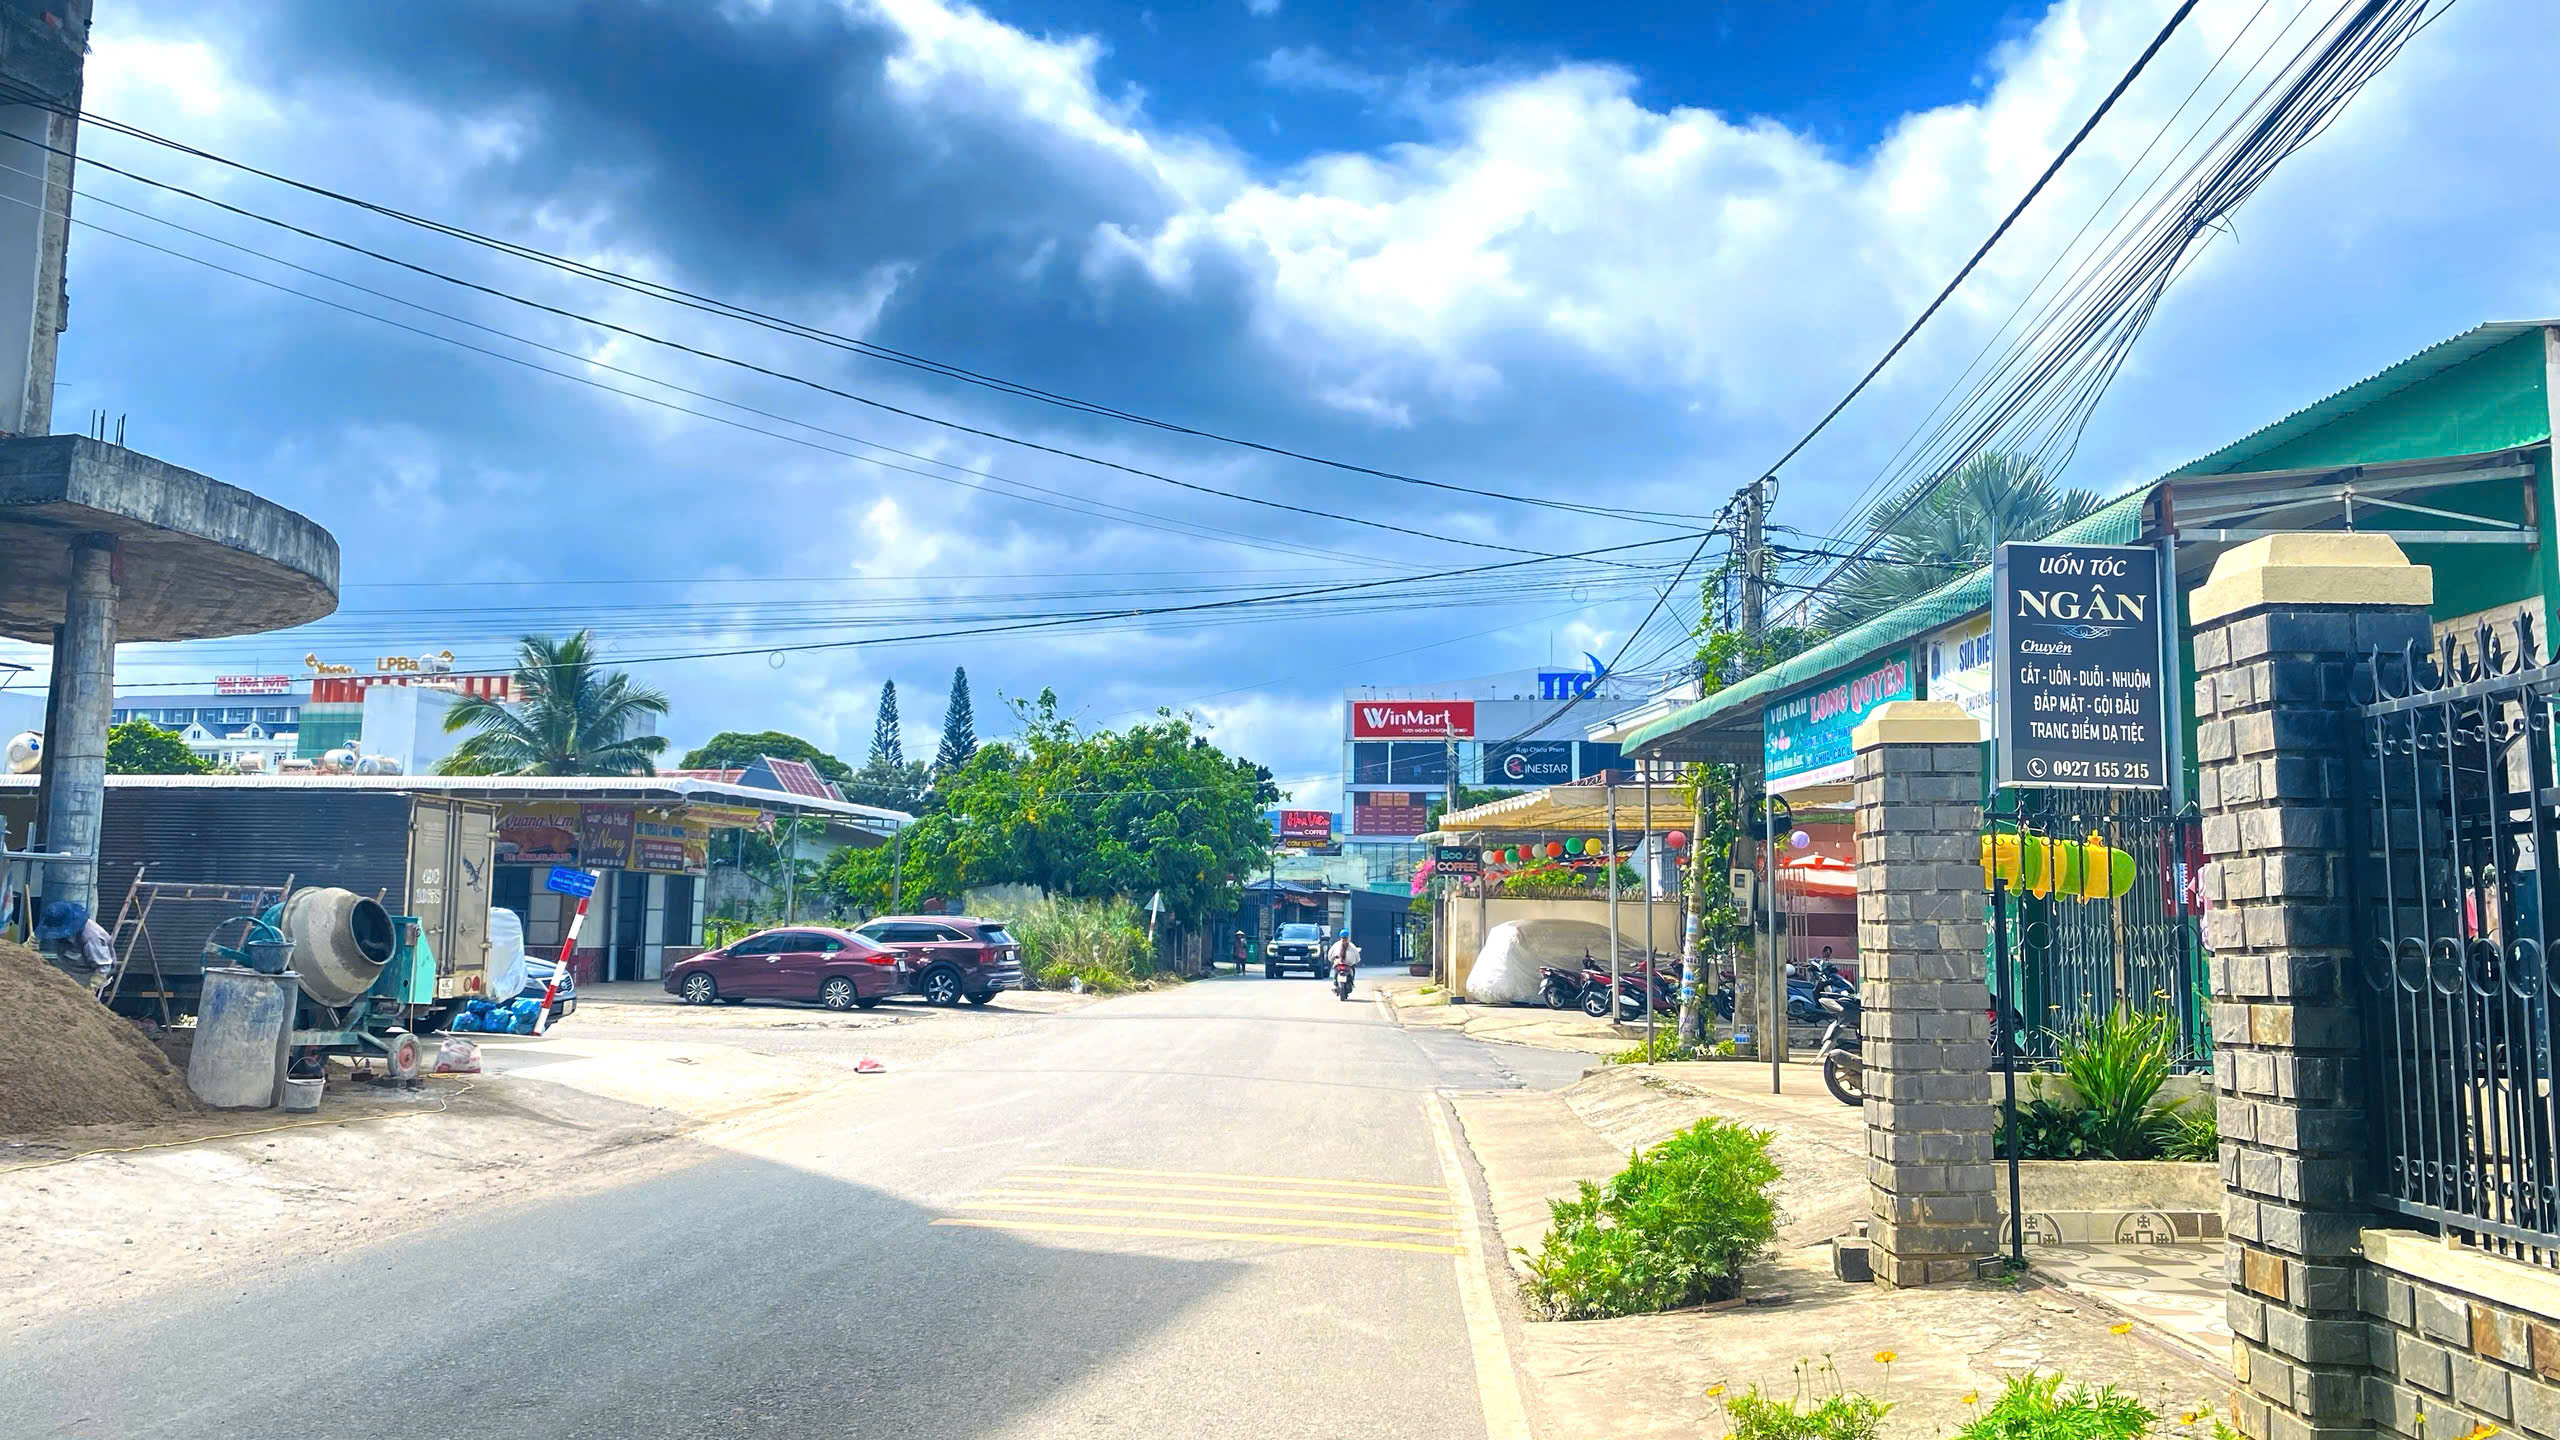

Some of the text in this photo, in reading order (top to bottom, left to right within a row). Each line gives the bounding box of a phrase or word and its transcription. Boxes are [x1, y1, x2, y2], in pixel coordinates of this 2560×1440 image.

[2039, 552, 2127, 576] UỐN TÓC
[2017, 584, 2147, 621] NGÂN
[1976, 627, 1992, 671] ĐIỆ
[2020, 639, 2072, 655] Chuyên
[1538, 673, 1597, 700] TTC
[2020, 662, 2040, 684] CẮT
[2048, 663, 2071, 686] UỐN
[2112, 669, 2151, 691] NHUỘM
[1789, 698, 1807, 719] RAU
[1809, 684, 1848, 724] LONG
[1850, 657, 1907, 714] QUYÊN
[2034, 689, 2057, 711] ĐẮP
[2059, 693, 2085, 715] MẶT
[2094, 694, 2113, 716] GỘI
[1363, 707, 1451, 729] WinMart
[2030, 717, 2145, 744] TRANG ĐIỂM DẠ TIỆC
[2053, 760, 2150, 779] 0927 155 215
[1436, 861, 1478, 872] COFFEE
[1440, 849, 1463, 860] Eco
